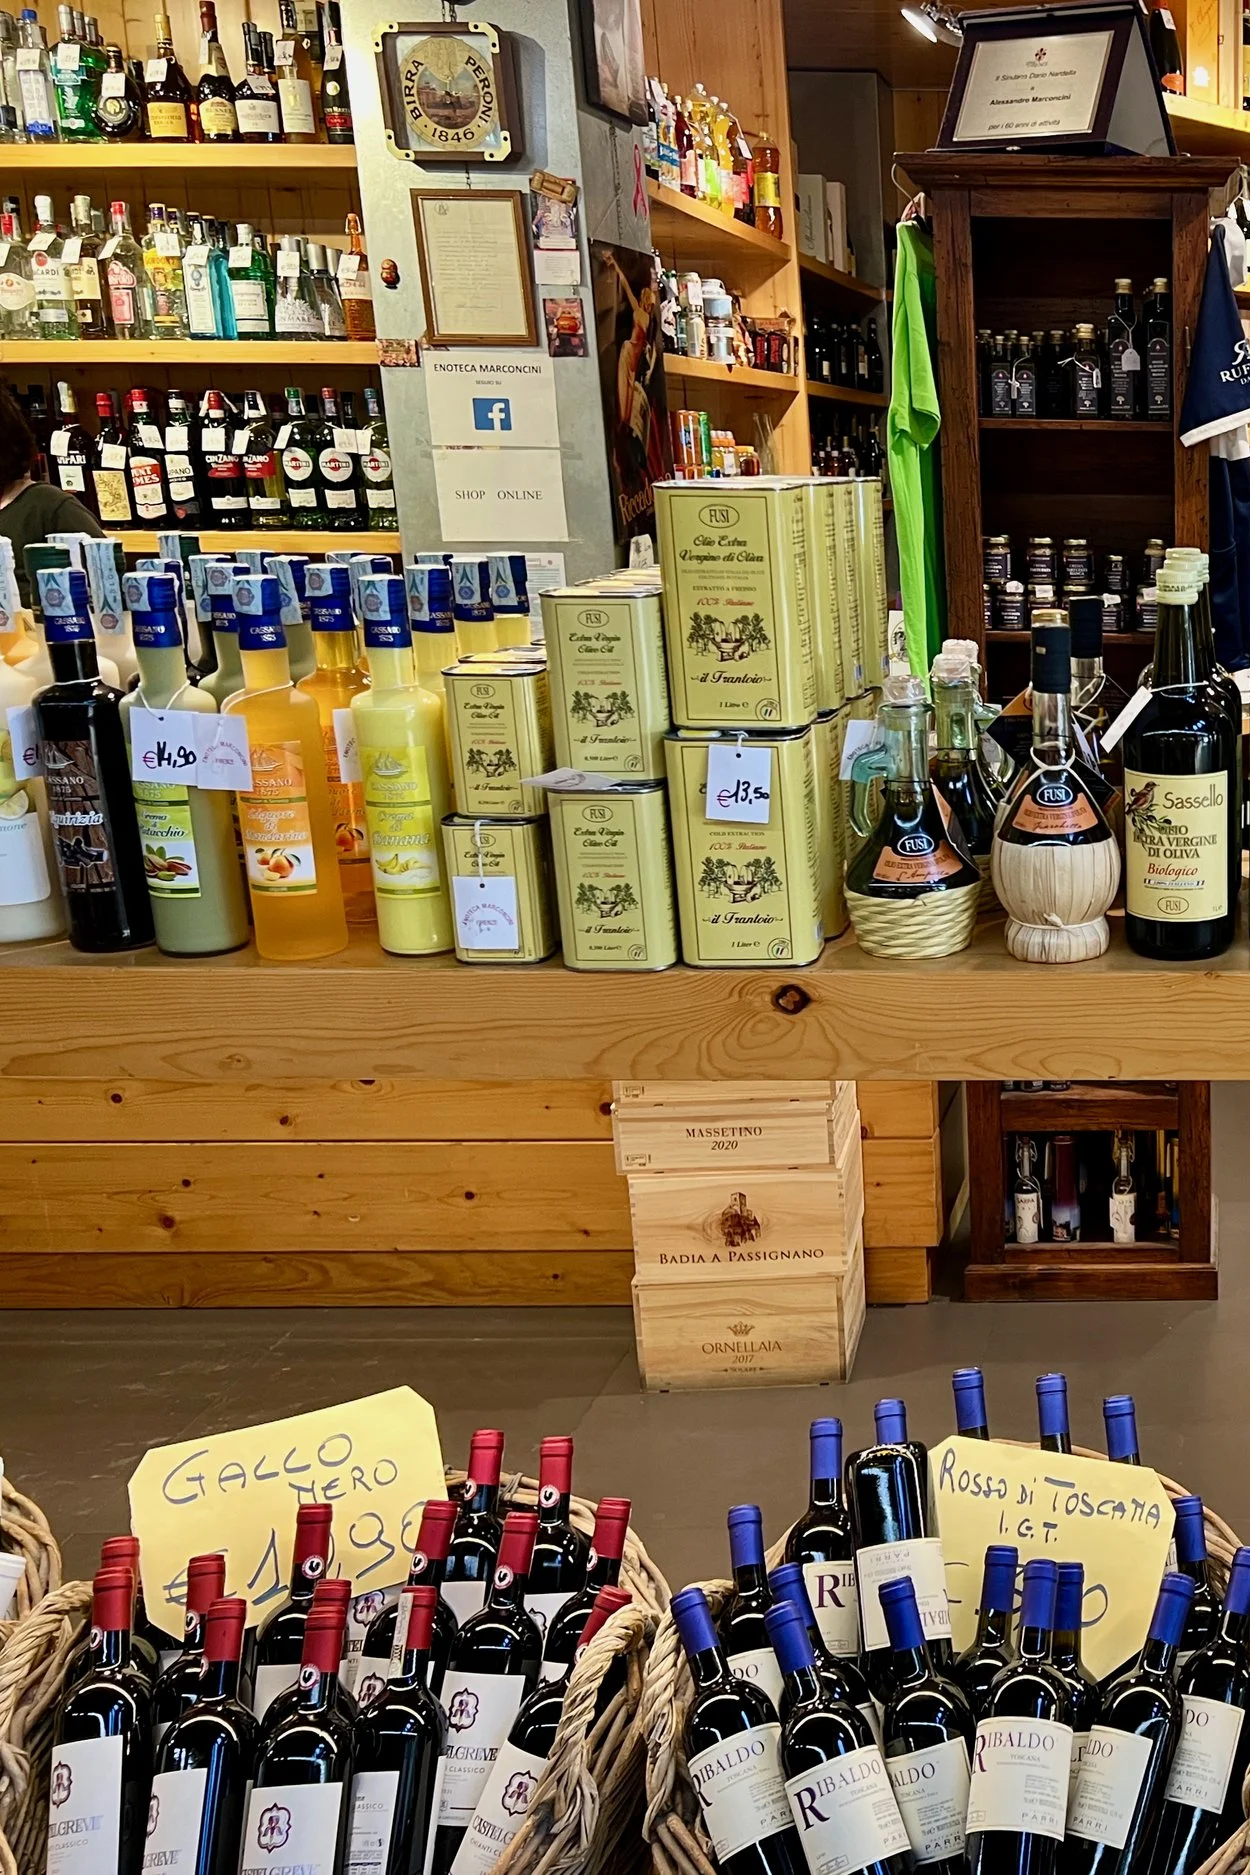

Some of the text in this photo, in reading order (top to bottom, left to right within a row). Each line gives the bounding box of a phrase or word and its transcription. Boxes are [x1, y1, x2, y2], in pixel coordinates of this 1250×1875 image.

[404, 55, 494, 124] BIRRA PERONI
[989, 93, 1071, 106] Alessandro Marconcini
[431, 128, 475, 143] 1846
[434, 363, 542, 374] ENOTECA MARCONCINI
[205, 454, 239, 463] CINZANO
[322, 460, 350, 468] MARTINI
[455, 490, 543, 500] SHOP ONLINE
[709, 509, 729, 523] FUSI
[693, 535, 747, 547] Olio Extra
[679, 550, 764, 564] Vergine di Oliva
[586, 613, 602, 625] FUSI
[700, 670, 763, 684] il Frantoio
[717, 780, 770, 808] €13,50
[1043, 789, 1065, 801] FUSI
[1163, 784, 1224, 809] Sassello
[589, 809, 606, 821] FUSI
[905, 838, 928, 851] FUSI
[1148, 848, 1200, 859] DI OLIVA
[1147, 863, 1198, 880] Biologico
[1165, 900, 1181, 911] FUSI
[711, 912, 774, 925] il Frantoio
[686, 1127, 762, 1138] MASSETINO
[711, 1140, 738, 1150] 2020
[659, 1249, 824, 1265] BADIA A PASSIGNANO
[702, 1340, 782, 1354] ORNELLAIA
[732, 1355, 754, 1364] 2017
[162, 1433, 353, 1505] GALLO
[973, 1733, 1055, 1774] RIBALDO
[449, 1765, 486, 1774] CLASSICO
[793, 1758, 882, 1832] RIBALDO
[1021, 1812, 1059, 1825] PARRI
[1073, 1816, 1108, 1831] PARRI
